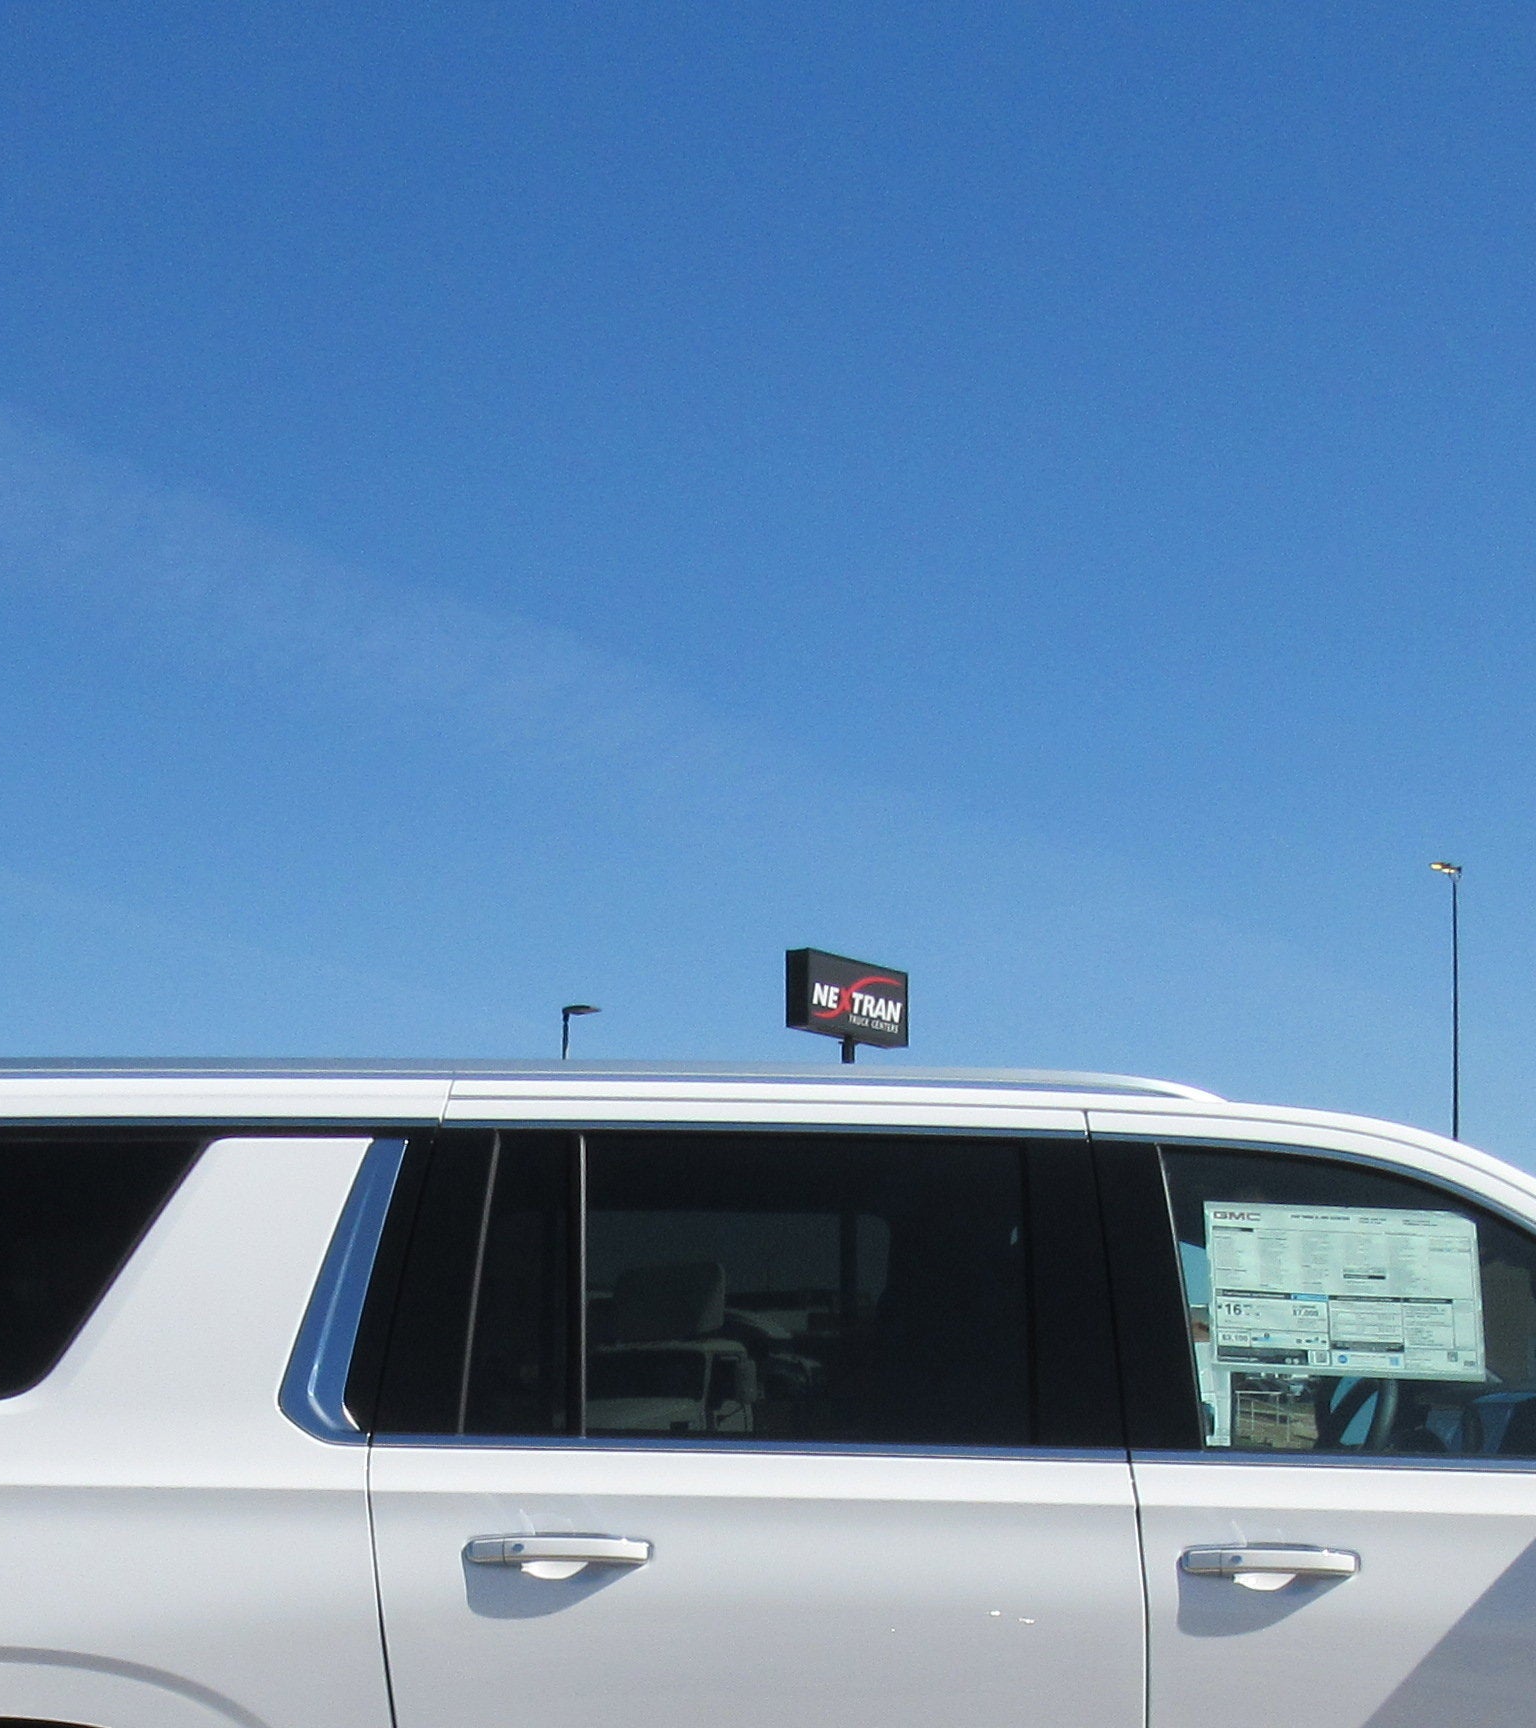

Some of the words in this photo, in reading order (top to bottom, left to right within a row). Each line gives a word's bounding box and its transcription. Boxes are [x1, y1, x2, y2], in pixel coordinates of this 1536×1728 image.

[812, 978, 902, 1023] NEXTRAN
[871, 1020, 898, 1034] CENTERS
[1213, 1210, 1261, 1222] GMC
[1225, 1303, 1242, 1316] 16
